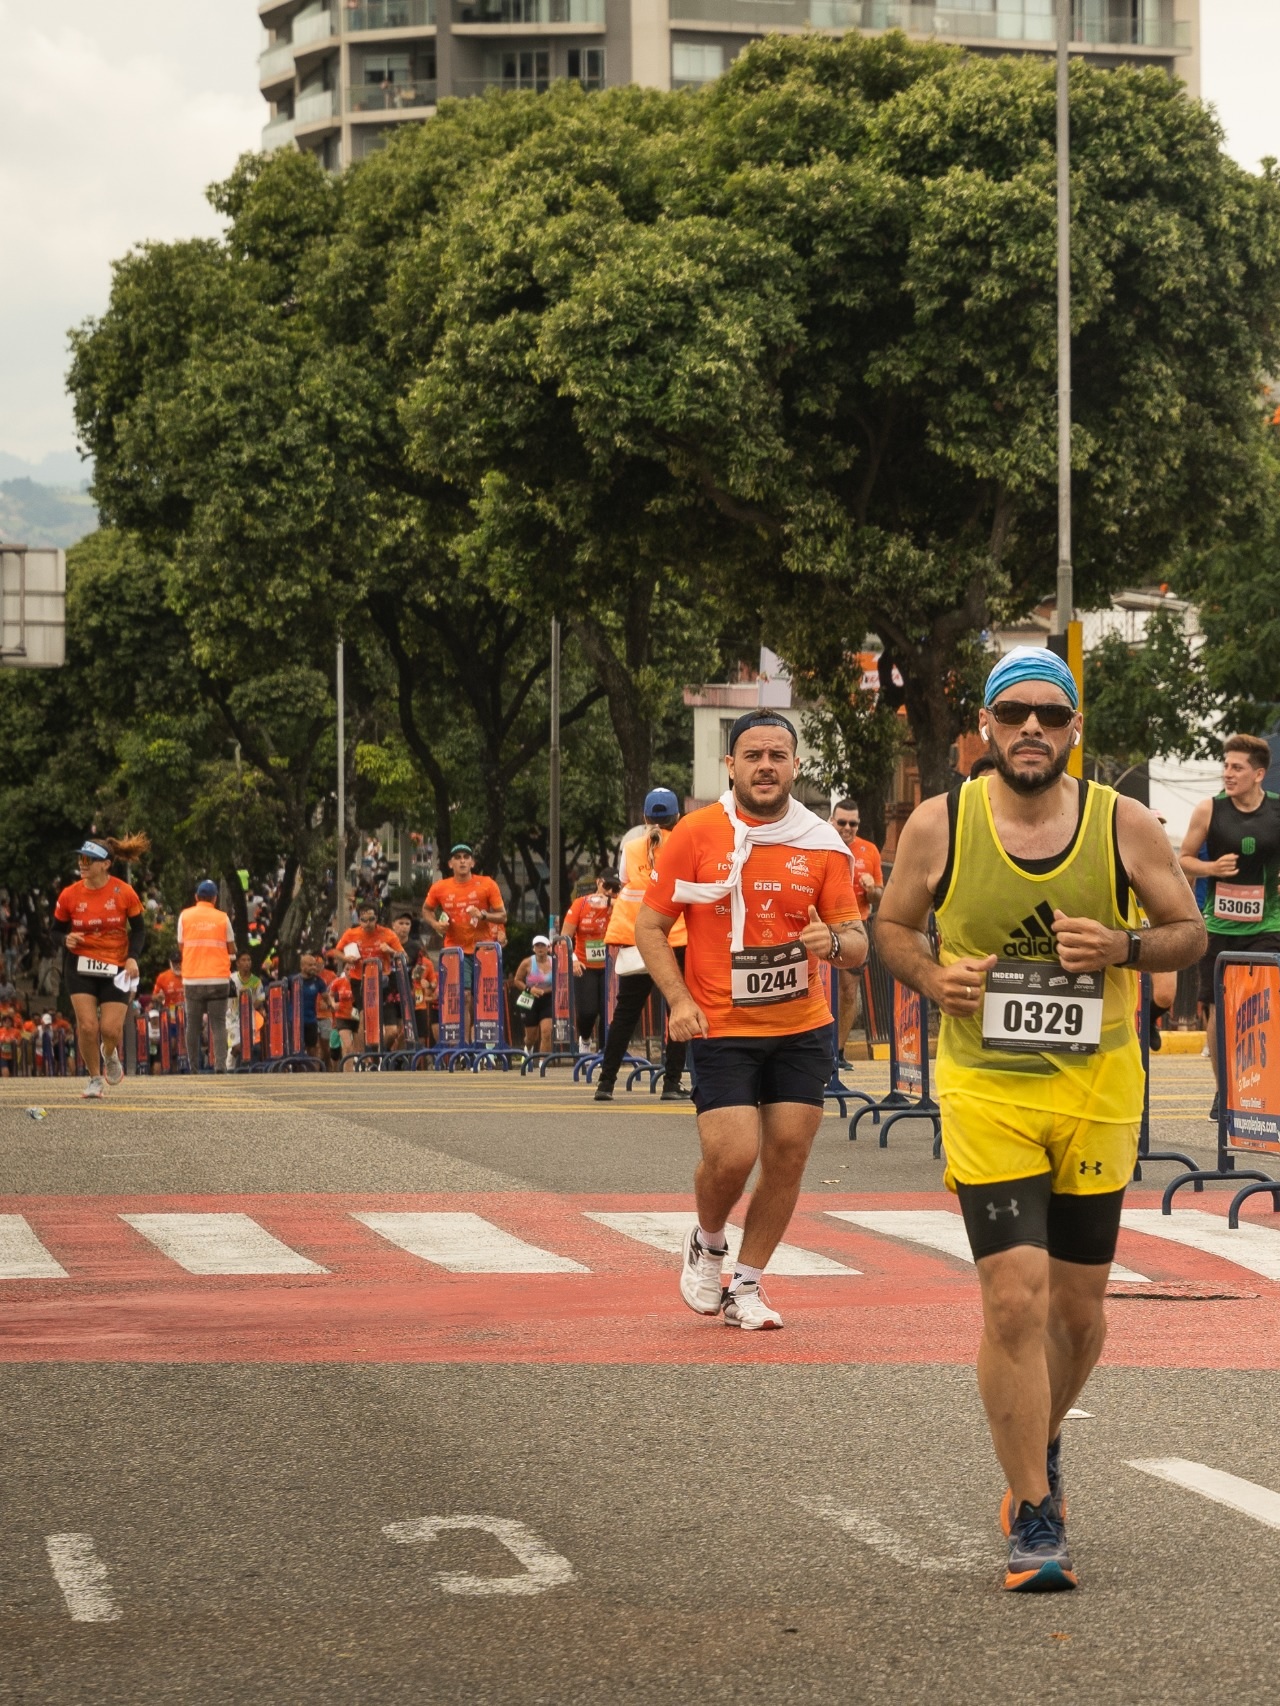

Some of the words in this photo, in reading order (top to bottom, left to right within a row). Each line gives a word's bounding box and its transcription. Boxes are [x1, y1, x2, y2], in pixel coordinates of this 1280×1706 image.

[1219, 898, 1260, 914] 53063
[87, 960, 109, 971] 1132
[747, 967, 797, 993] 0244
[1003, 1000, 1084, 1036] 0329
[1236, 988, 1270, 1043] PEOPLE
